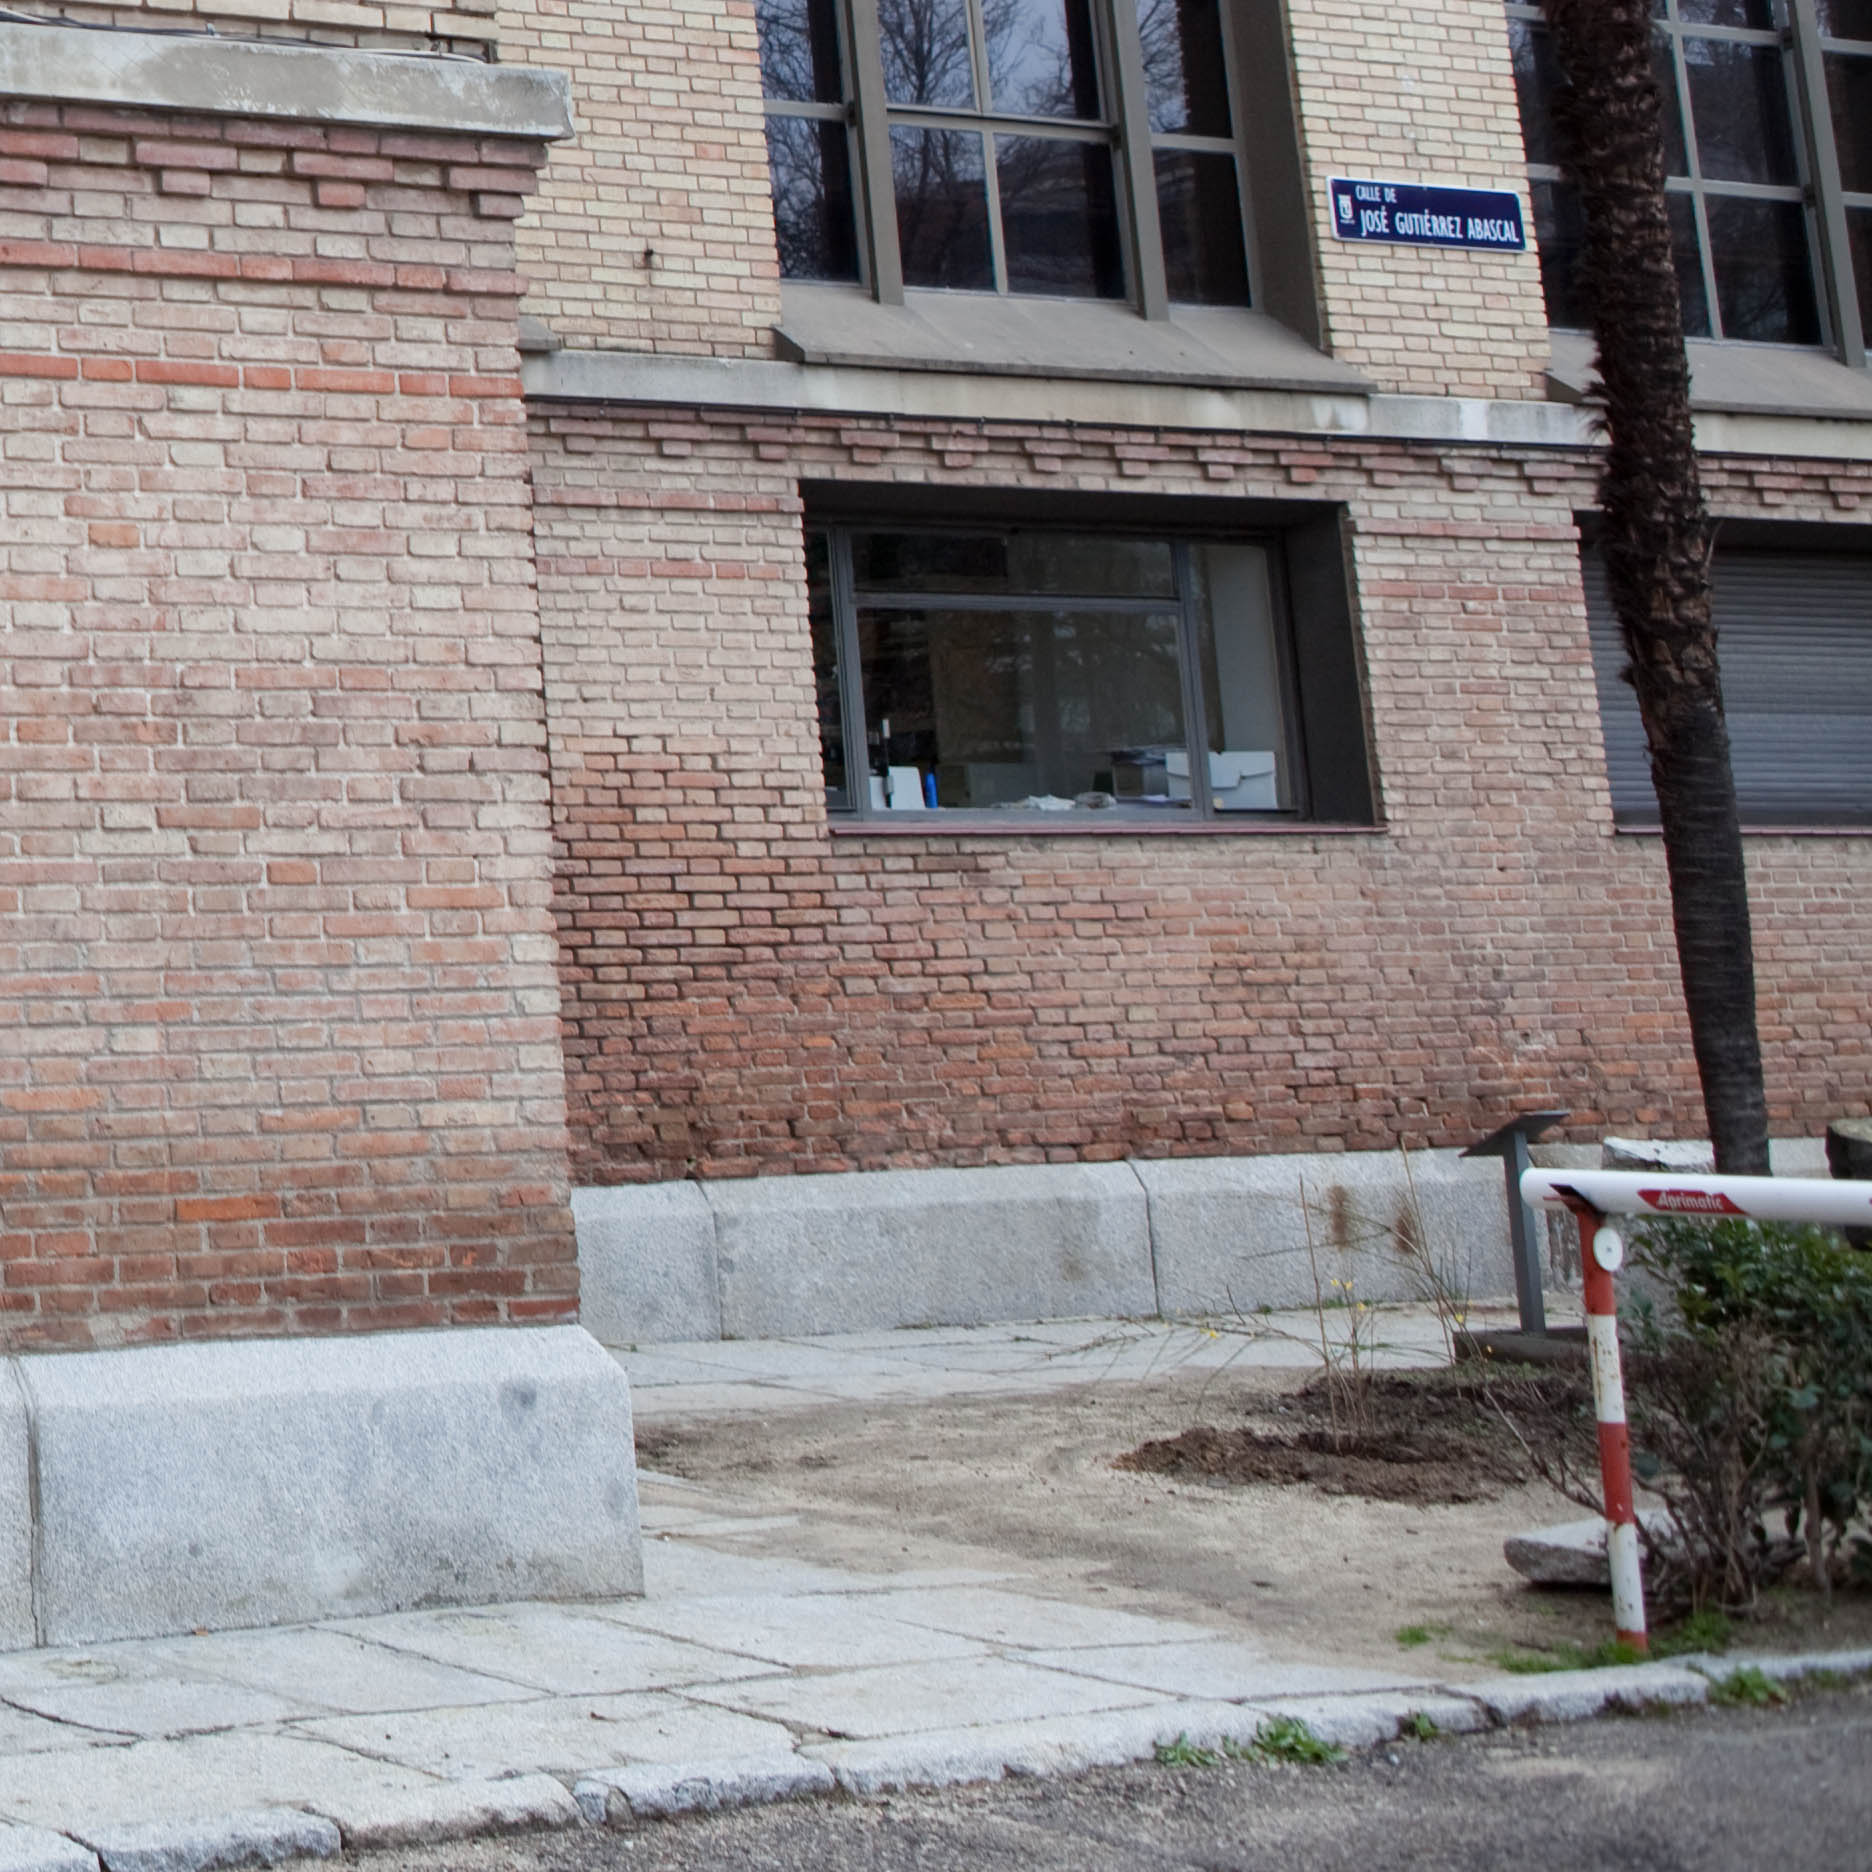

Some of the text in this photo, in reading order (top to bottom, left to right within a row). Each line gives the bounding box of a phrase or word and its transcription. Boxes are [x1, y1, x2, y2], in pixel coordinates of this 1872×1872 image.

[1355, 184, 1397, 204] CALLE DE
[1360, 205, 1520, 243] JOSÉ GUTIÉRREZ ABASCAL
